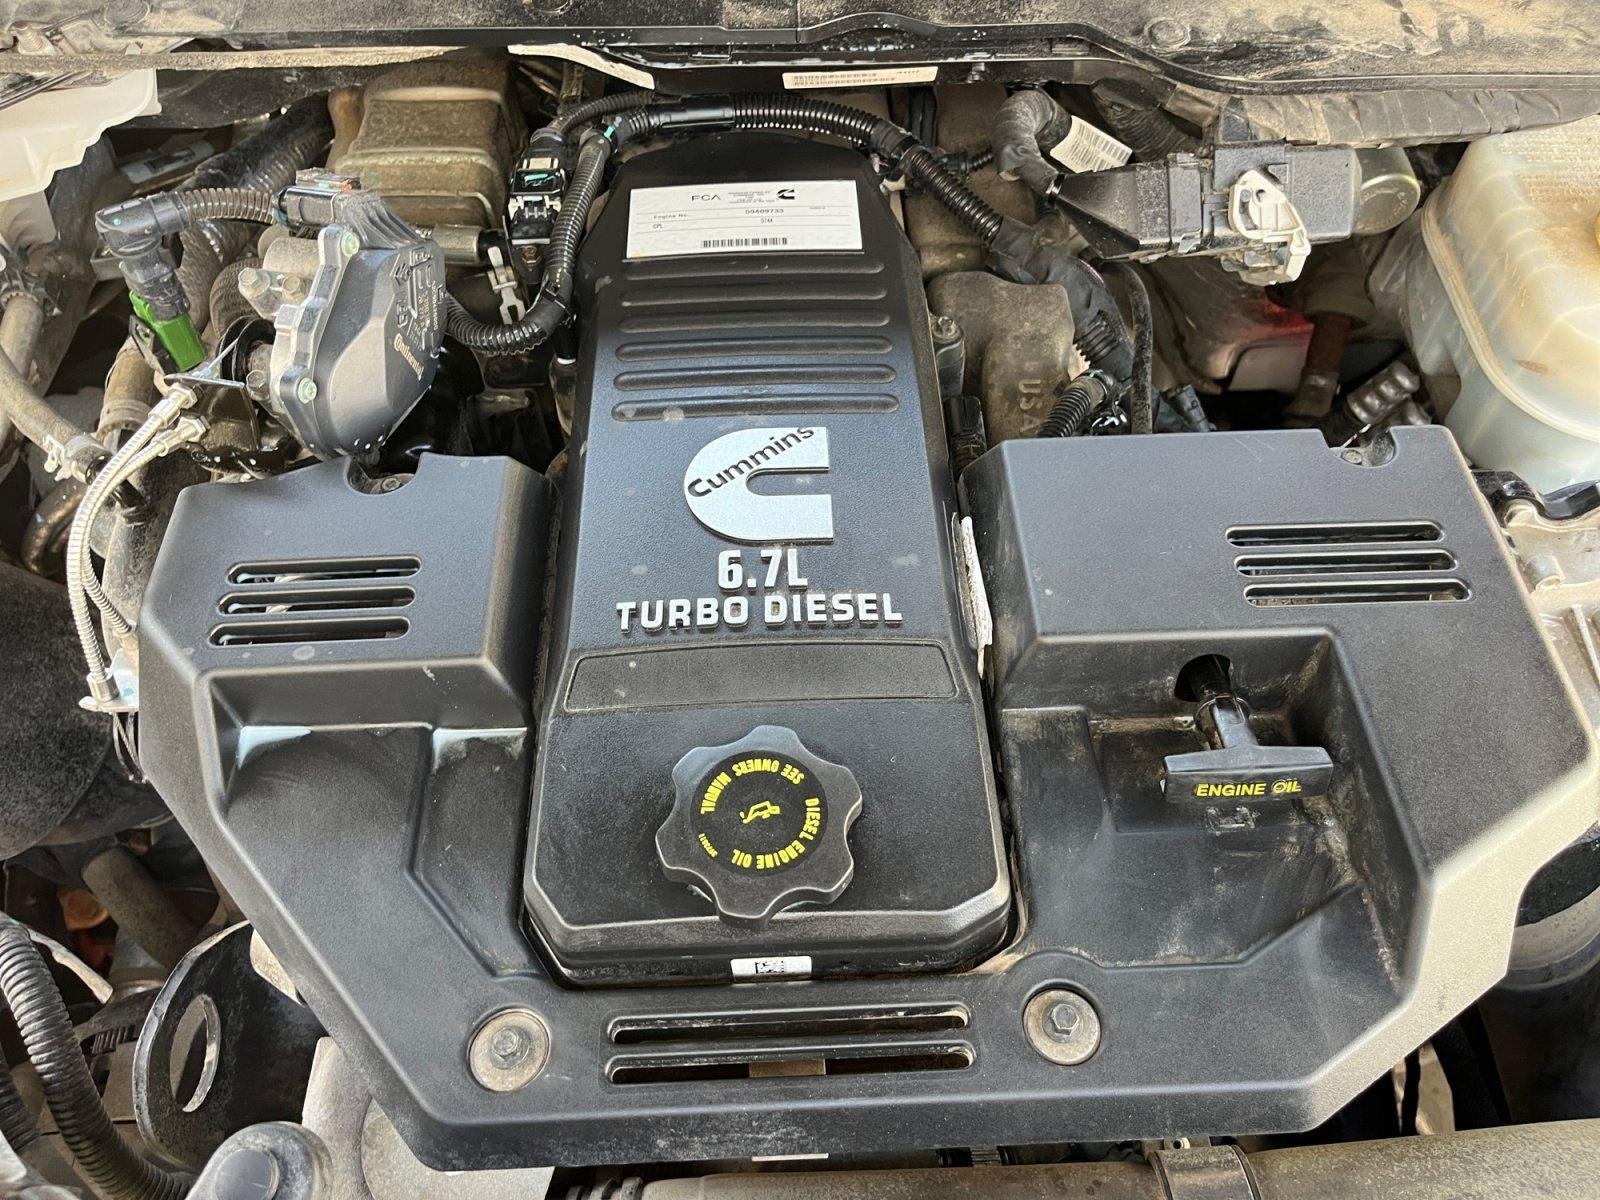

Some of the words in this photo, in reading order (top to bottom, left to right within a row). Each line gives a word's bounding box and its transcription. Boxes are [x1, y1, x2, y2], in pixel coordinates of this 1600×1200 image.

[1019, 379, 1045, 432] USA
[688, 427, 814, 496] Cummins
[718, 548, 808, 590] 6.7L
[616, 596, 749, 634] TURBO
[764, 592, 904, 626] DIESEL
[732, 758, 780, 776] OWNERS
[781, 764, 805, 784] SEE
[1197, 783, 1267, 797] ENGINE
[1272, 779, 1302, 794] OIL
[701, 772, 732, 814] MANUAL
[799, 797, 821, 841] DIESEL
[733, 849, 752, 868] OIL
[756, 840, 806, 869] ENGINE
